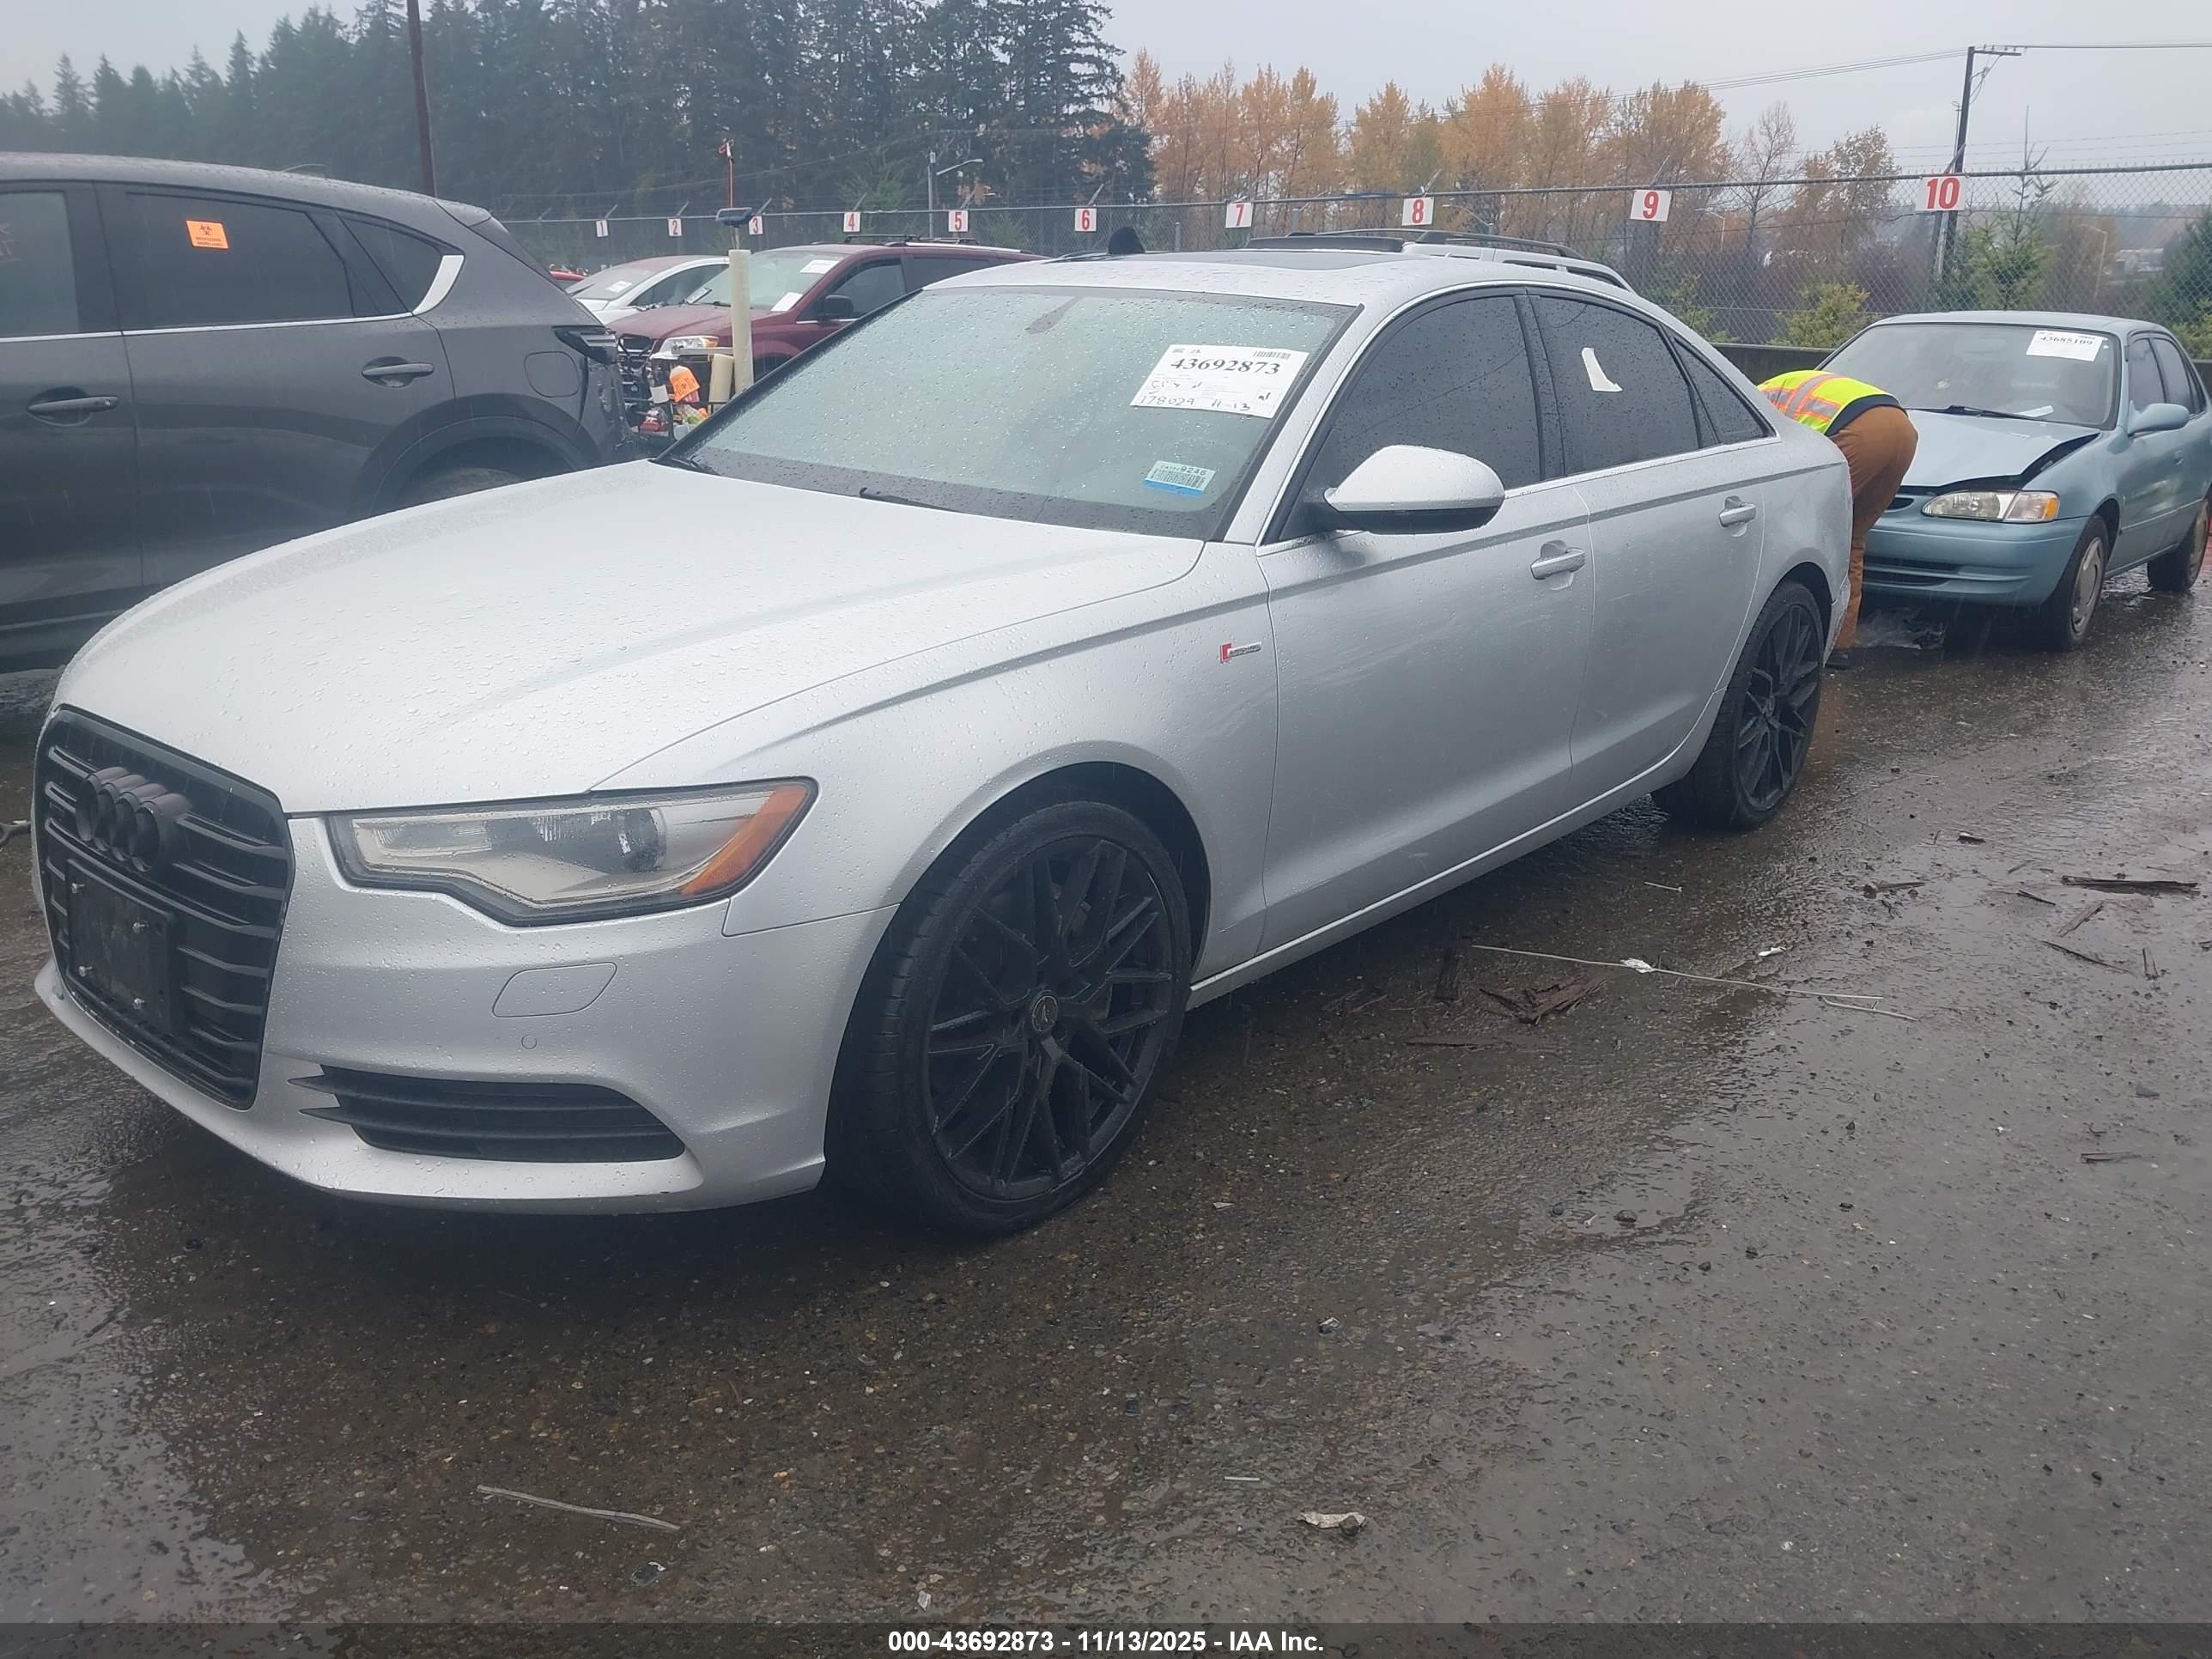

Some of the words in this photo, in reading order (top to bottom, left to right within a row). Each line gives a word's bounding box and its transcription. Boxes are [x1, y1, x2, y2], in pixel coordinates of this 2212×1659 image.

[1926, 177, 1961, 210] 10
[1411, 199, 1425, 224] 8
[1643, 191, 1660, 219] 9
[848, 213, 855, 231] 4
[954, 212, 962, 230] 5
[1081, 210, 1091, 230] 6
[1235, 202, 1244, 227] 7
[599, 221, 605, 235] 1
[672, 220, 678, 235] 2
[752, 217, 760, 234] 3
[1170, 358, 1280, 375] 43692873
